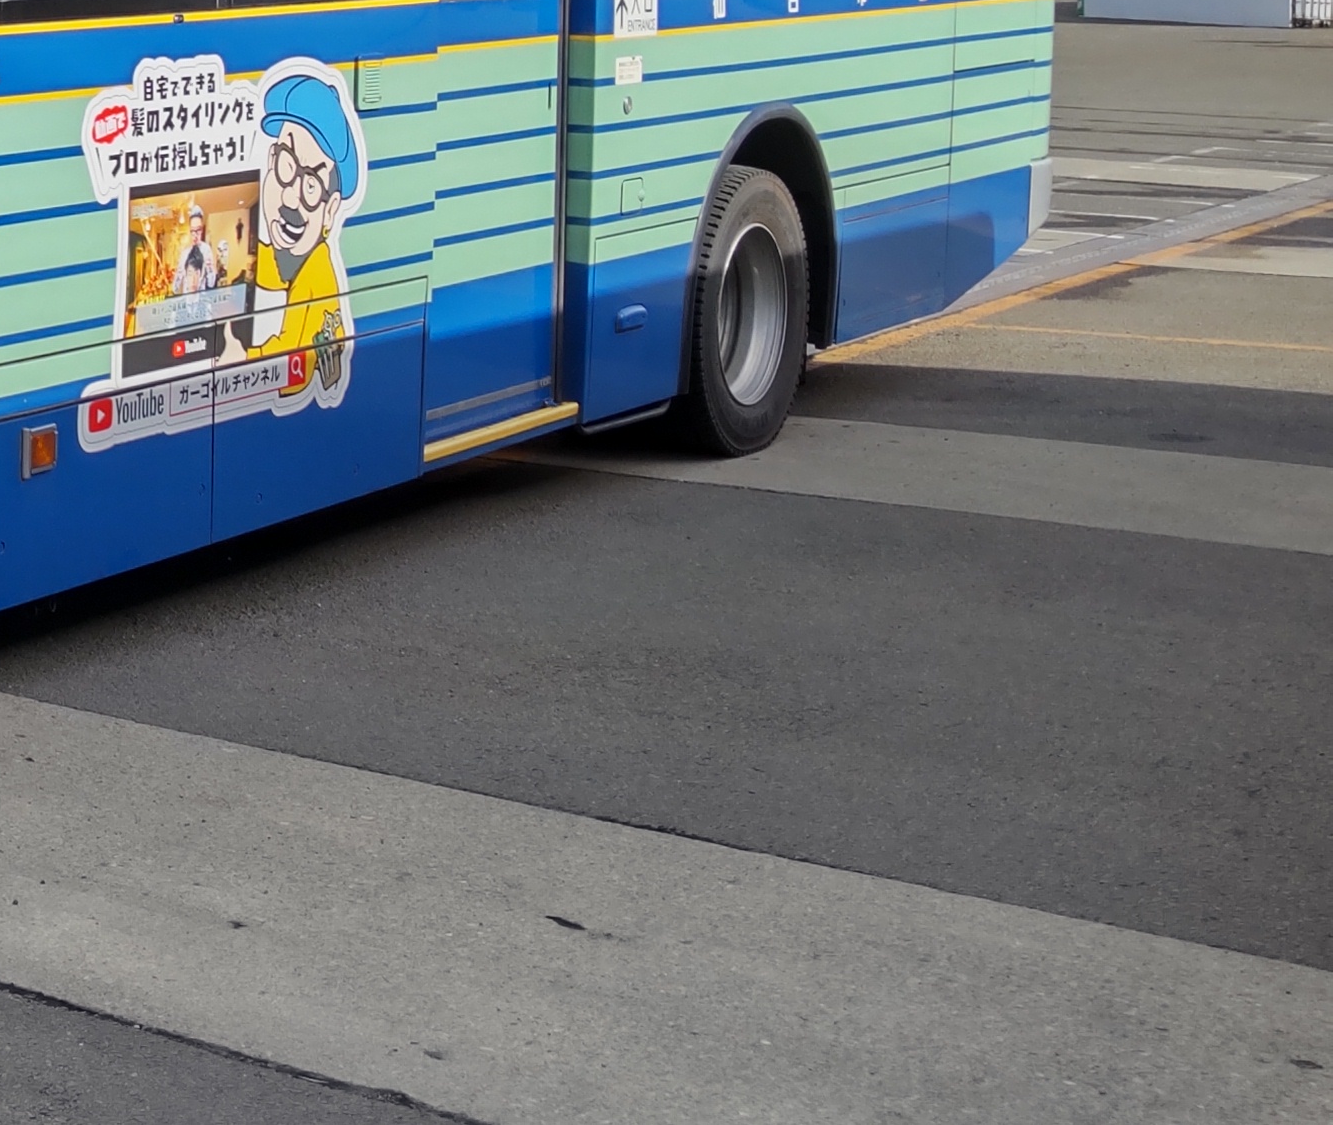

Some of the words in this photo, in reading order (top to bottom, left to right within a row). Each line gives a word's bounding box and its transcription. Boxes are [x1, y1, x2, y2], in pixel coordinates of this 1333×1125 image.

[627, 17, 657, 33] ENTRANCE
[143, 72, 216, 102] 自宅でできる
[130, 96, 255, 138] 髪のスタイリングを
[178, 364, 281, 406] ガーゴイルチャンネル
[115, 391, 165, 425] YouTube
